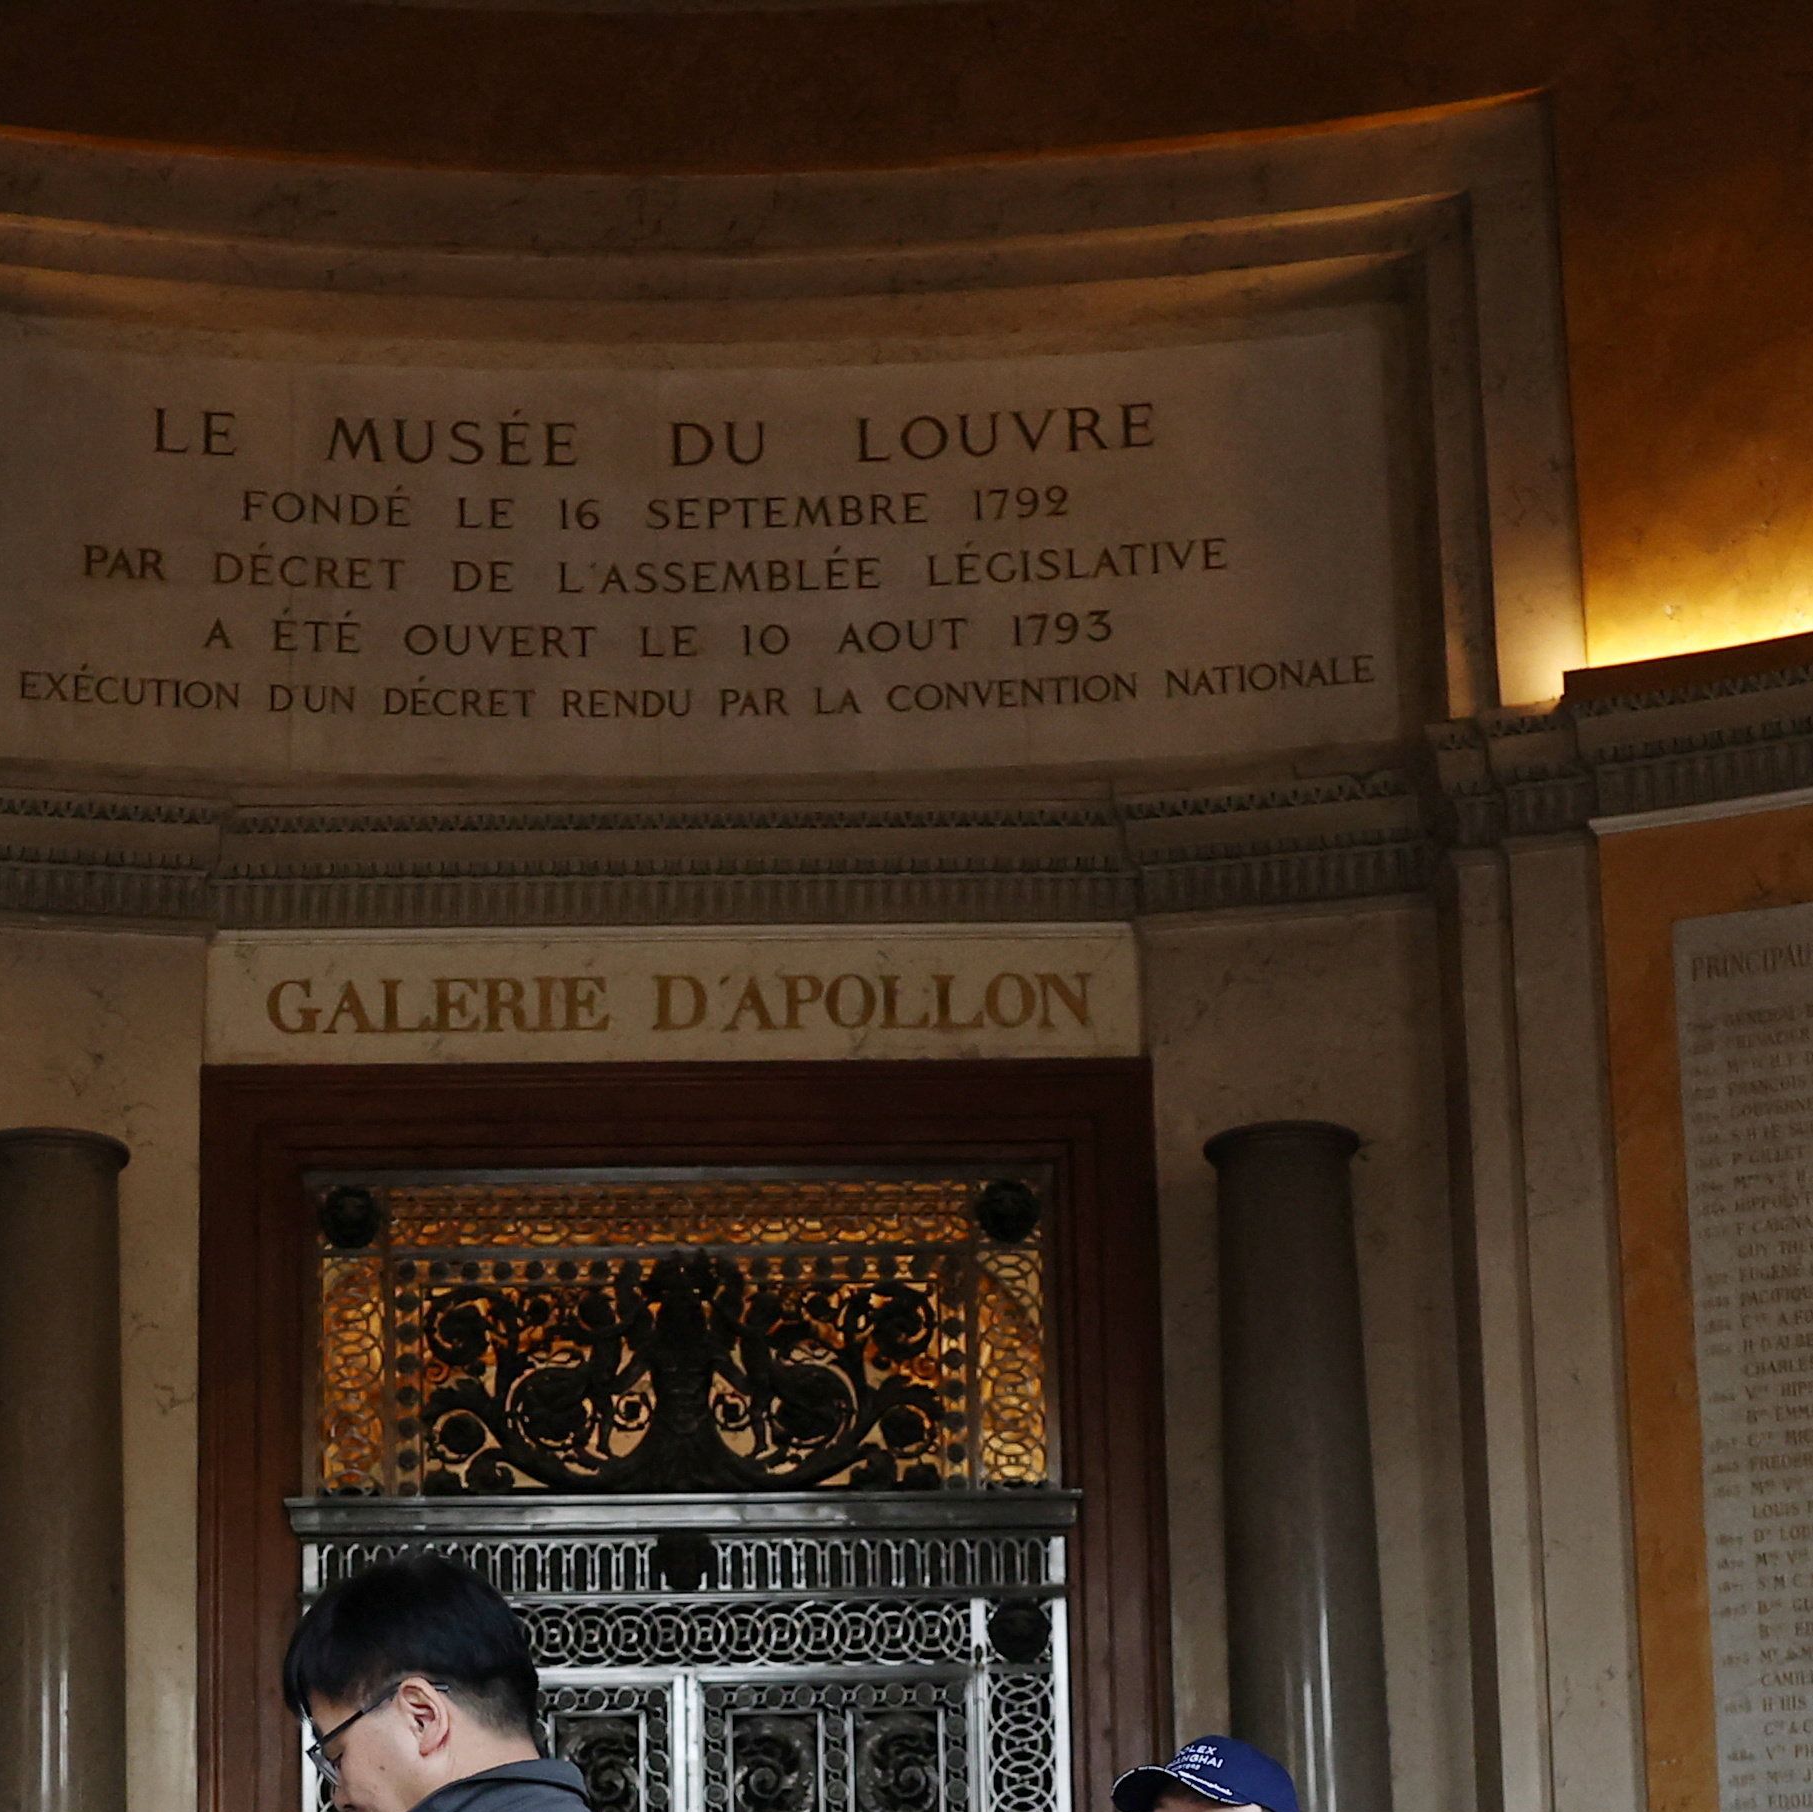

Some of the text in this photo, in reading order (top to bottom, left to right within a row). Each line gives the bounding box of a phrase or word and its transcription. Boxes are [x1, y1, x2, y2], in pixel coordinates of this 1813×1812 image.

[154, 403, 1156, 467] LE MUSÉE DU LOUVRE
[241, 485, 1070, 531] FONDÉ LE 16 SEPTEMBRE 1792
[84, 540, 1228, 594] PAR DÉCRET DE L'ASSEMBLÉE LÉGISLATIVE
[203, 607, 1114, 658] A ÉTÉ OUVERT LE 10 AOUT 1793
[20, 664, 241, 711] EXÉCUTION
[383, 674, 536, 718] DÉCRET
[563, 688, 689, 719] RENDU
[720, 687, 787, 717] PAR
[814, 686, 861, 716] LA
[889, 671, 1138, 713] CONVENTION
[1163, 654, 1375, 699] NATIONALE
[265, 972, 1093, 1036] GALERIE D'APOLLON
